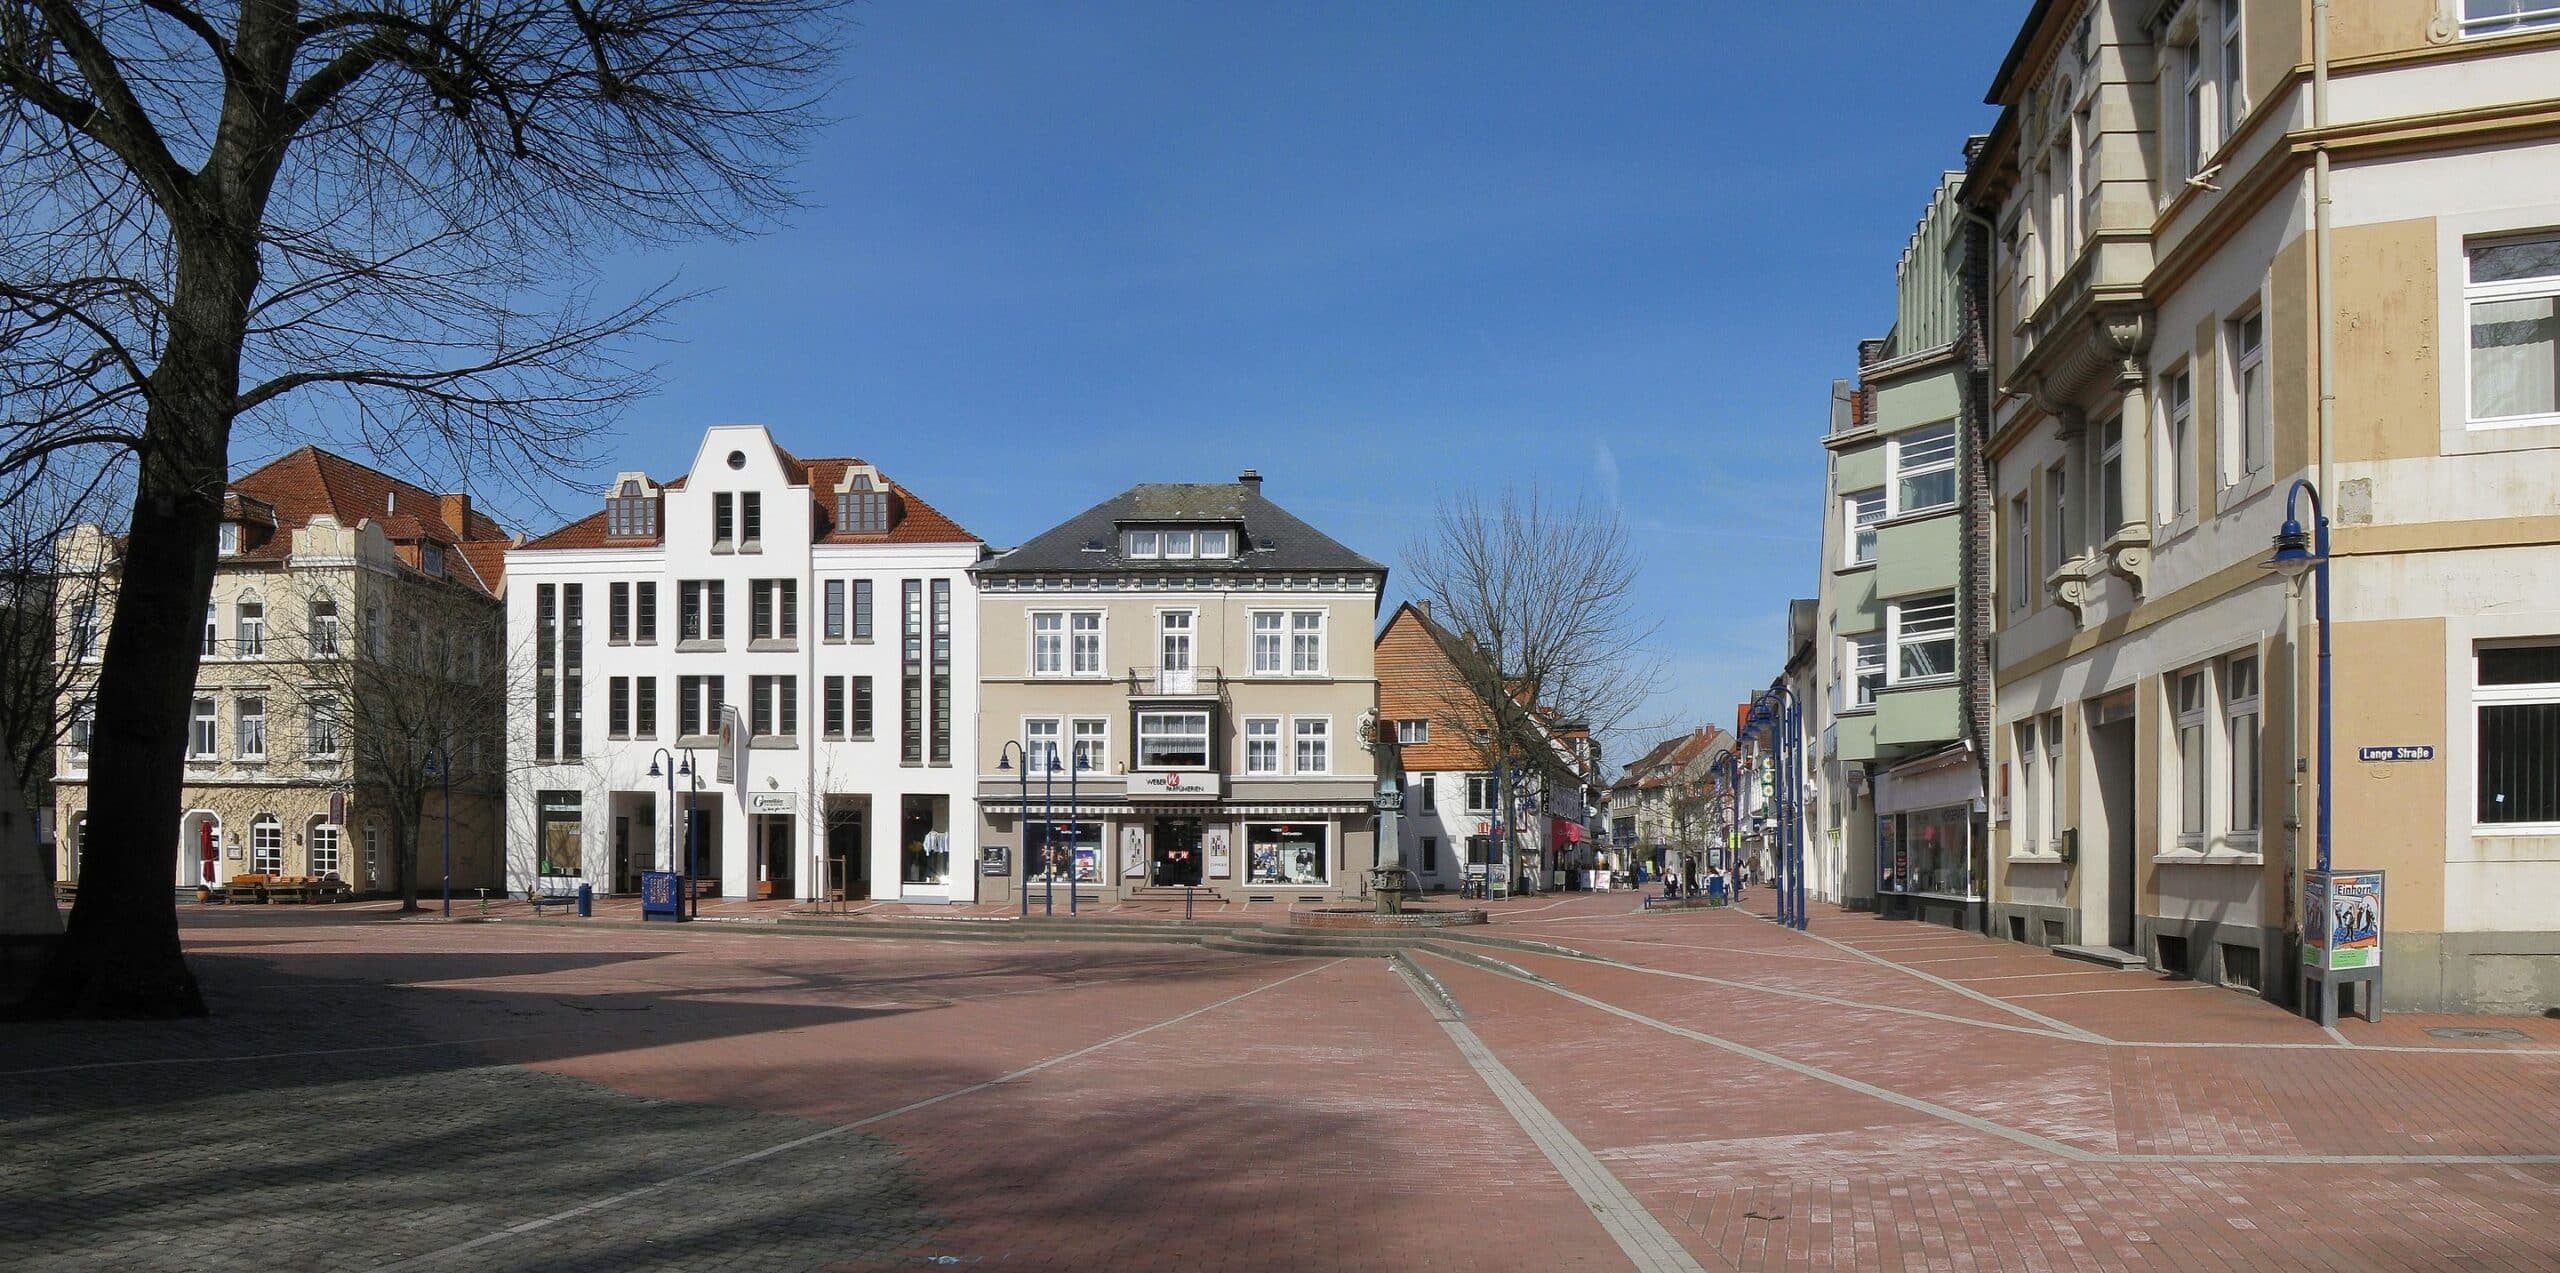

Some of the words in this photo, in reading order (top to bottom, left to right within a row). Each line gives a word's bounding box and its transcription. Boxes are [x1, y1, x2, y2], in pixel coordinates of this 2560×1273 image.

[2363, 748, 2392, 760] Lange
[2397, 747, 2429, 760] Straße
[1146, 778, 1166, 786] WEBER
[2337, 884, 2372, 896] Einhorn
